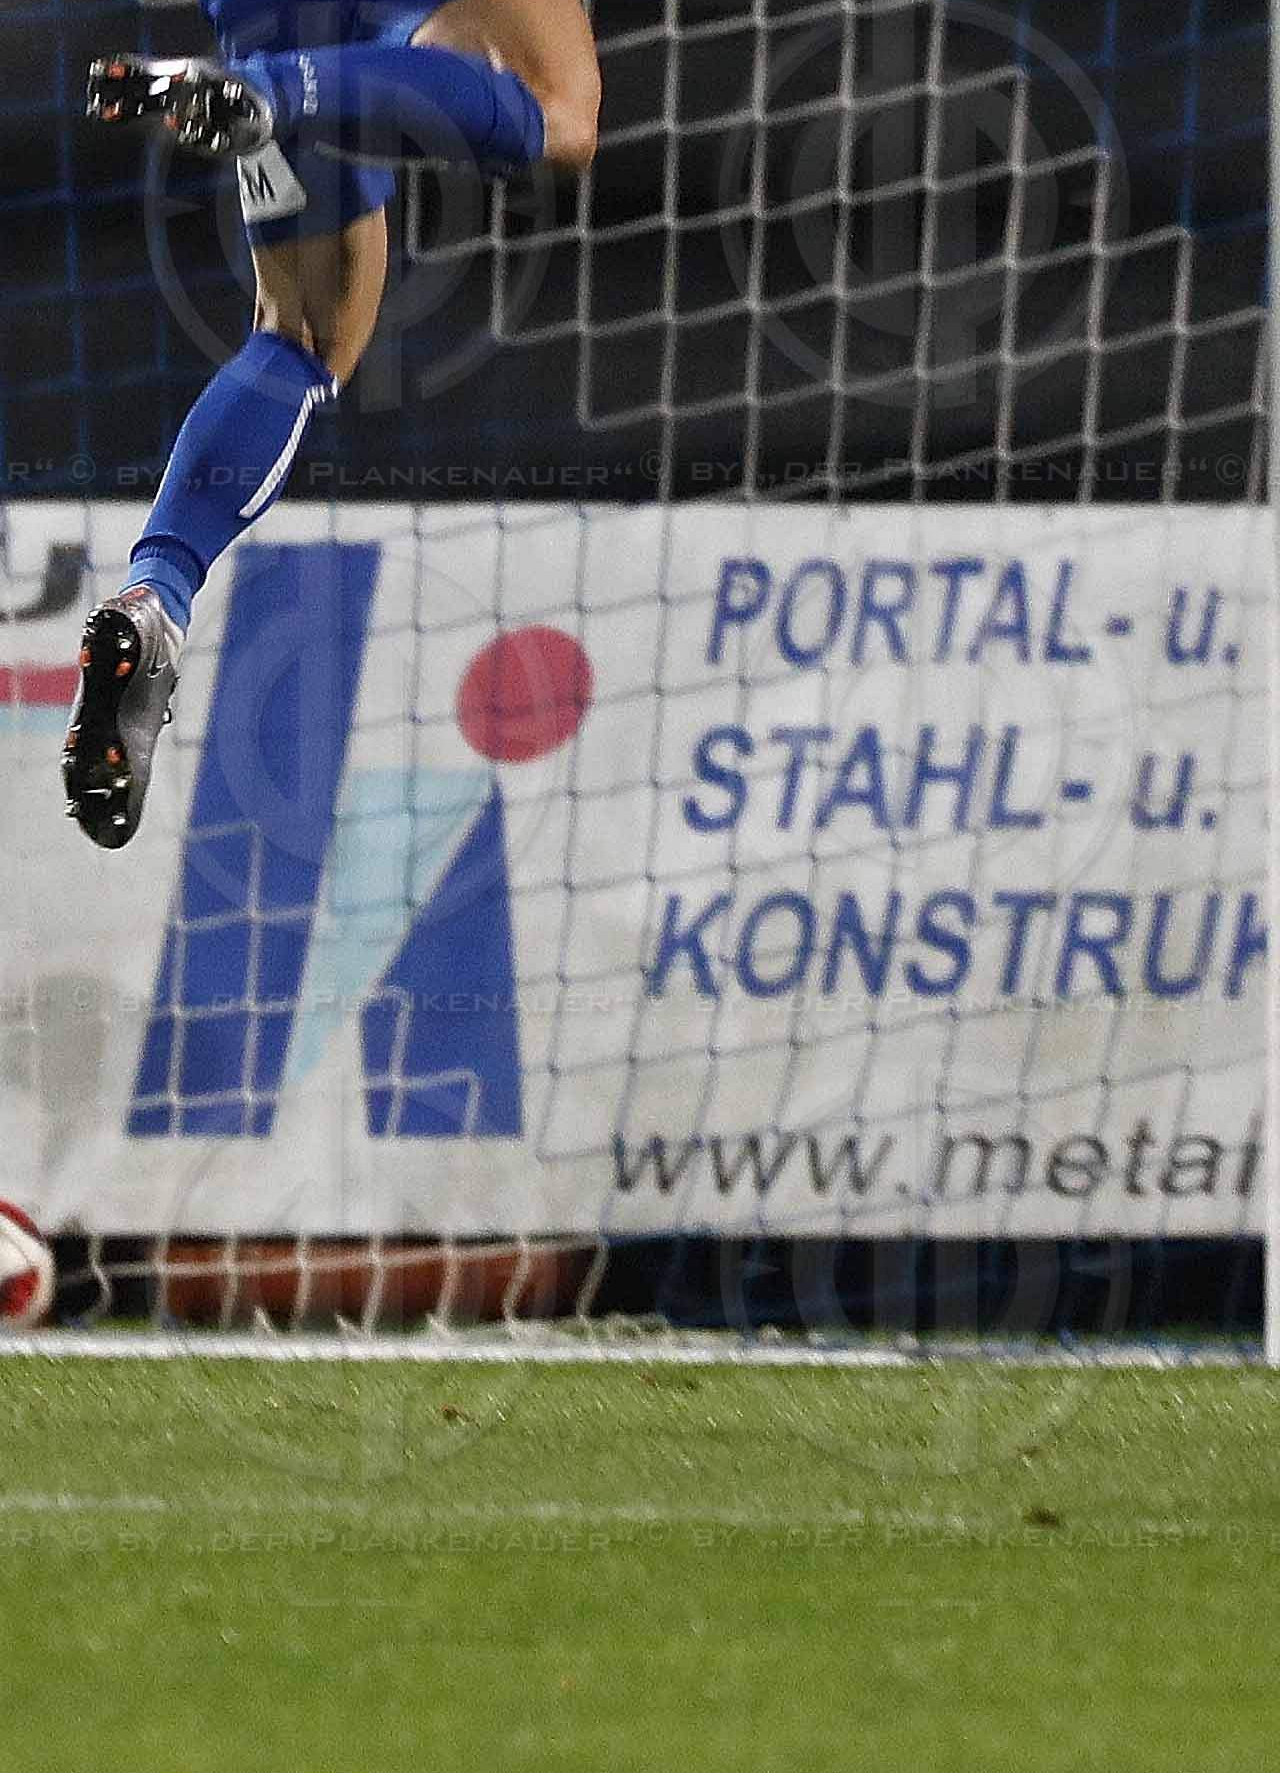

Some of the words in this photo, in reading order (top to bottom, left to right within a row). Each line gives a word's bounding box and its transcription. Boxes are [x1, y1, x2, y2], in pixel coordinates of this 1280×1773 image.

[704, 557, 1135, 668] PORTAL-
[1162, 584, 1243, 666] u.
[682, 724, 1095, 834] STAHL-
[1130, 751, 1217, 832] u.
